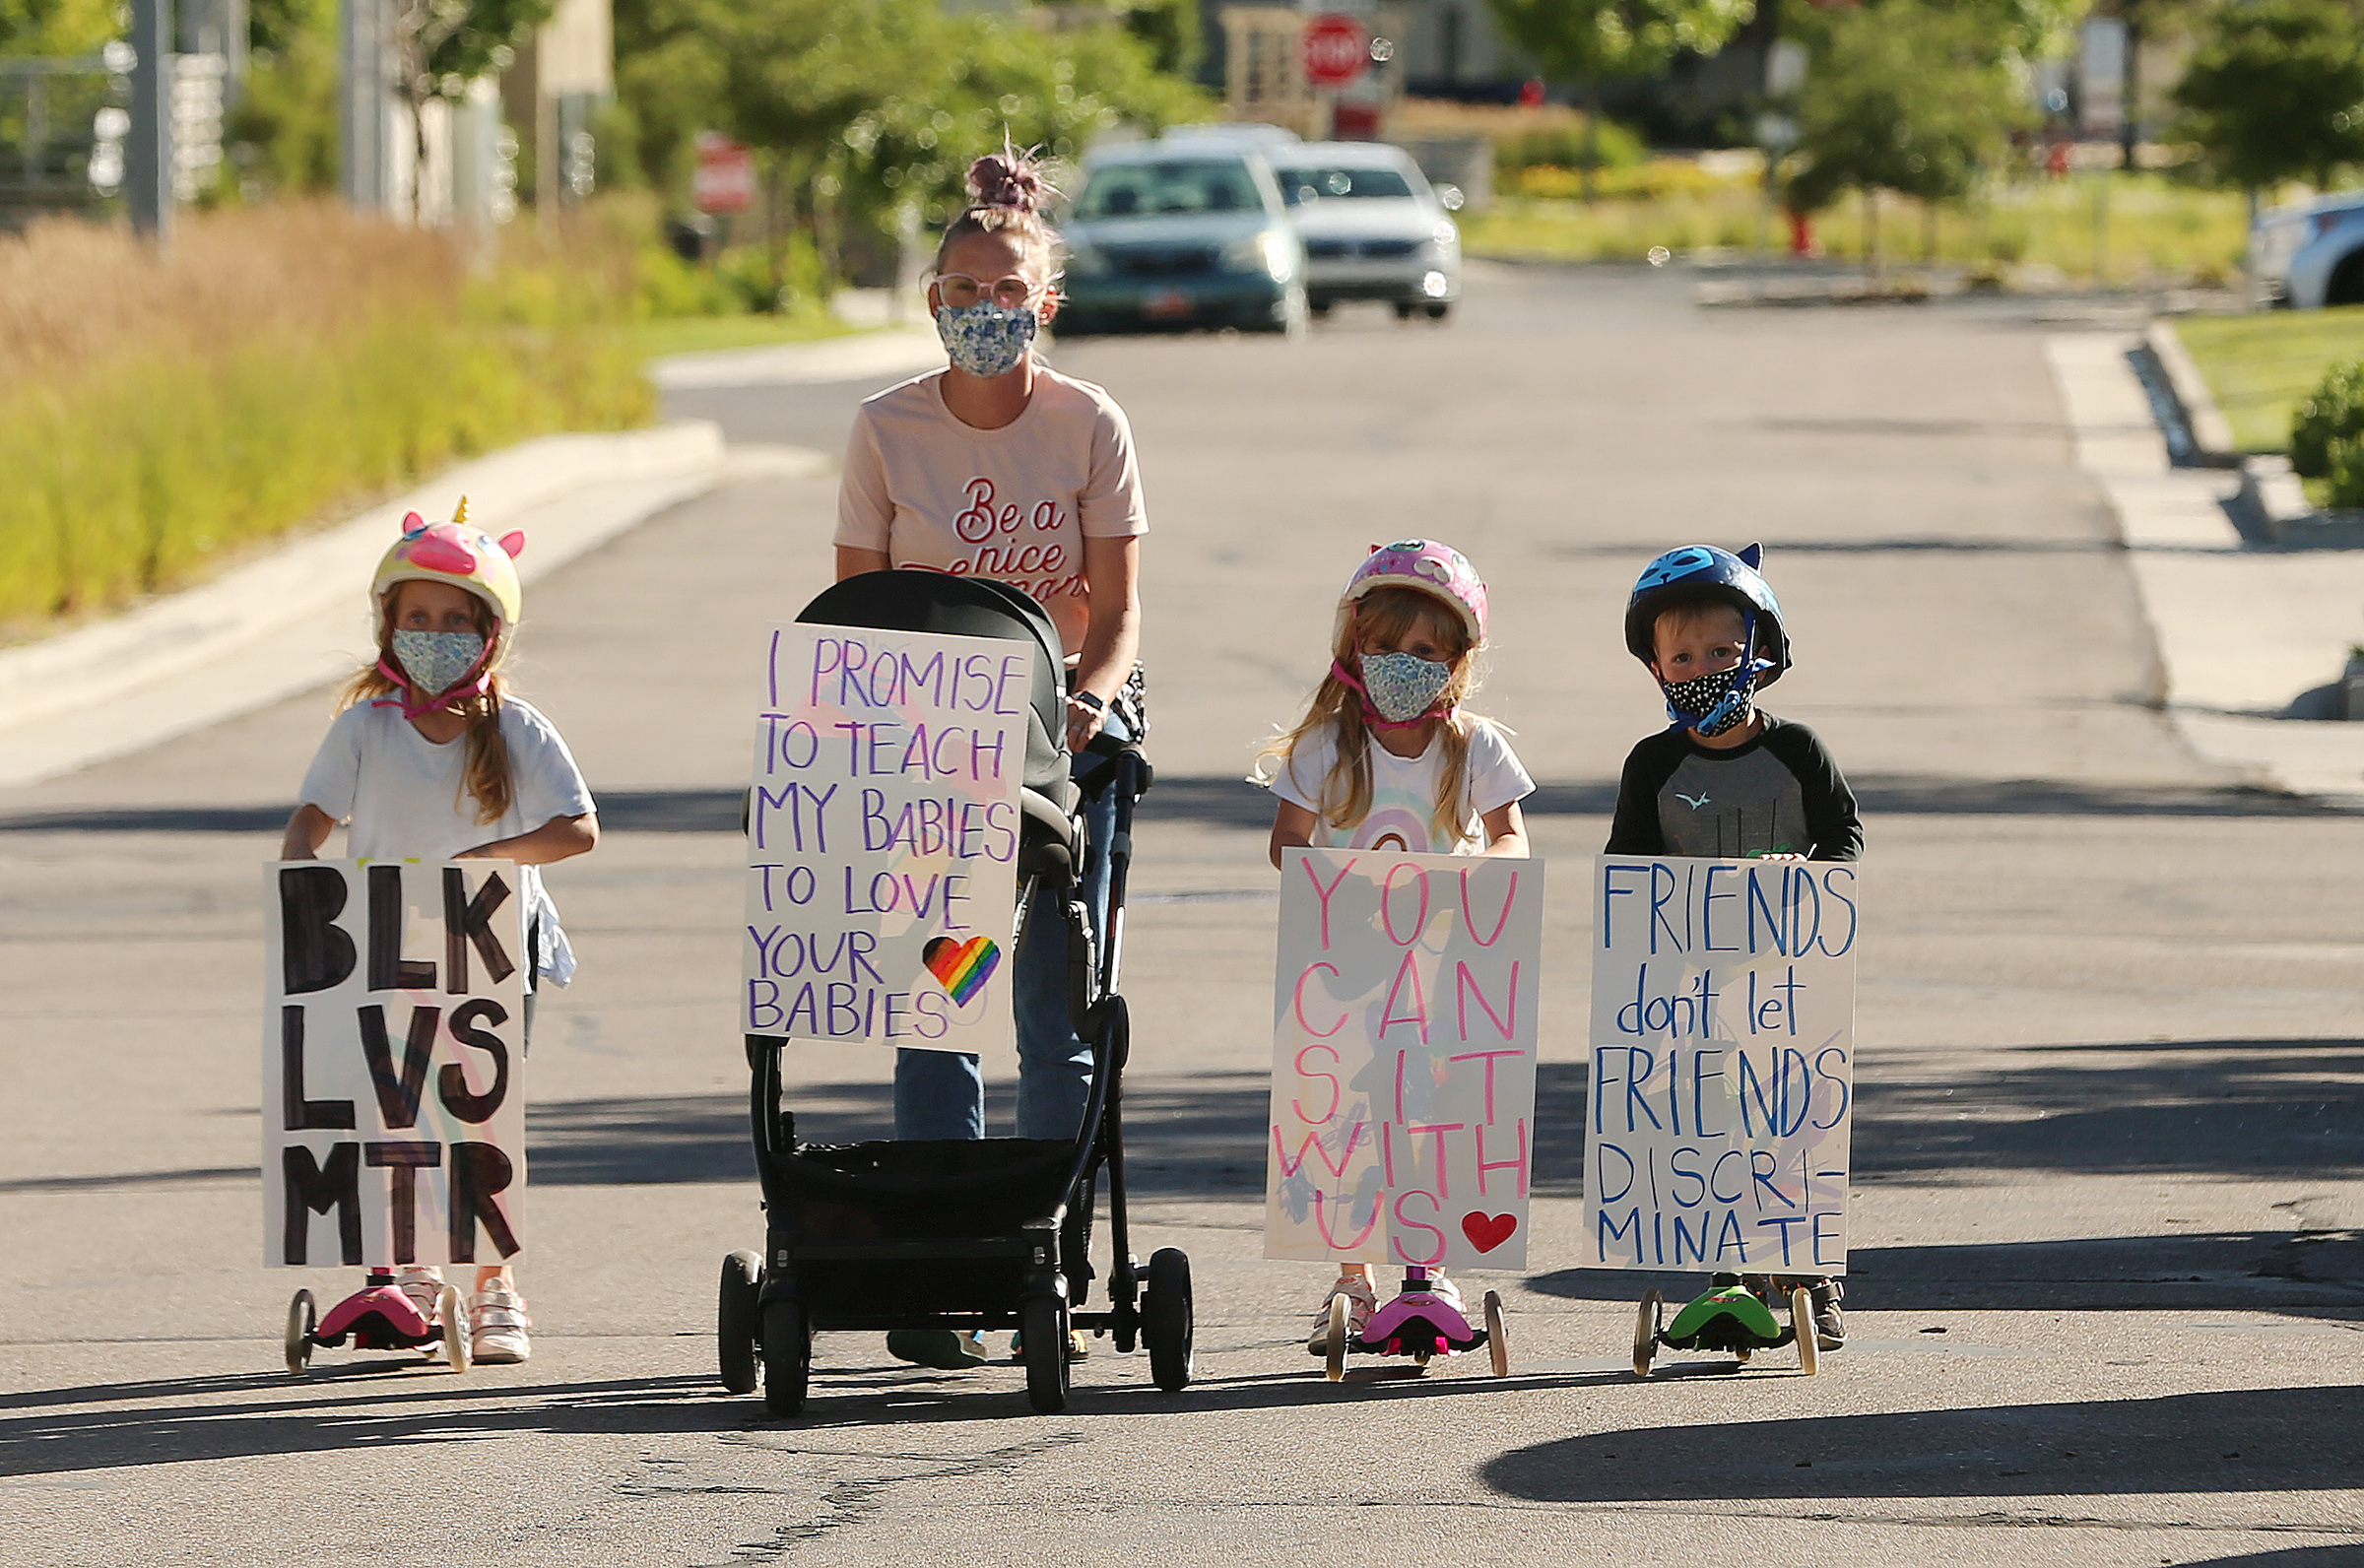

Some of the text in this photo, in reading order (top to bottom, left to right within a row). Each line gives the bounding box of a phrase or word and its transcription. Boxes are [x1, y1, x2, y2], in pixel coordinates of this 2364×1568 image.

[952, 476, 1066, 544] Be a
[972, 537, 1068, 574] nice
[768, 630, 1025, 715] I PROMISE
[760, 713, 1005, 781] TO TEACH
[756, 782, 1016, 862] MY BABIES
[280, 865, 515, 995] BLK
[751, 864, 971, 930] TO LOVE
[1301, 857, 1518, 950] YOU
[1605, 863, 1856, 957] FRIENDS
[748, 925, 885, 984] YOUR
[749, 979, 949, 1038] BABIES
[1294, 950, 1519, 1044] CAN
[1616, 963, 1806, 1038] don't let
[282, 999, 509, 1130] LVS
[1291, 1044, 1526, 1125] SIT
[1596, 1046, 1849, 1138] FRIENDS
[1274, 1118, 1529, 1200] WITH
[1599, 1143, 1846, 1212] DISCRI-
[283, 1142, 521, 1265] MTR
[1316, 1190, 1446, 1265] US
[1599, 1208, 1846, 1267] MINATE
